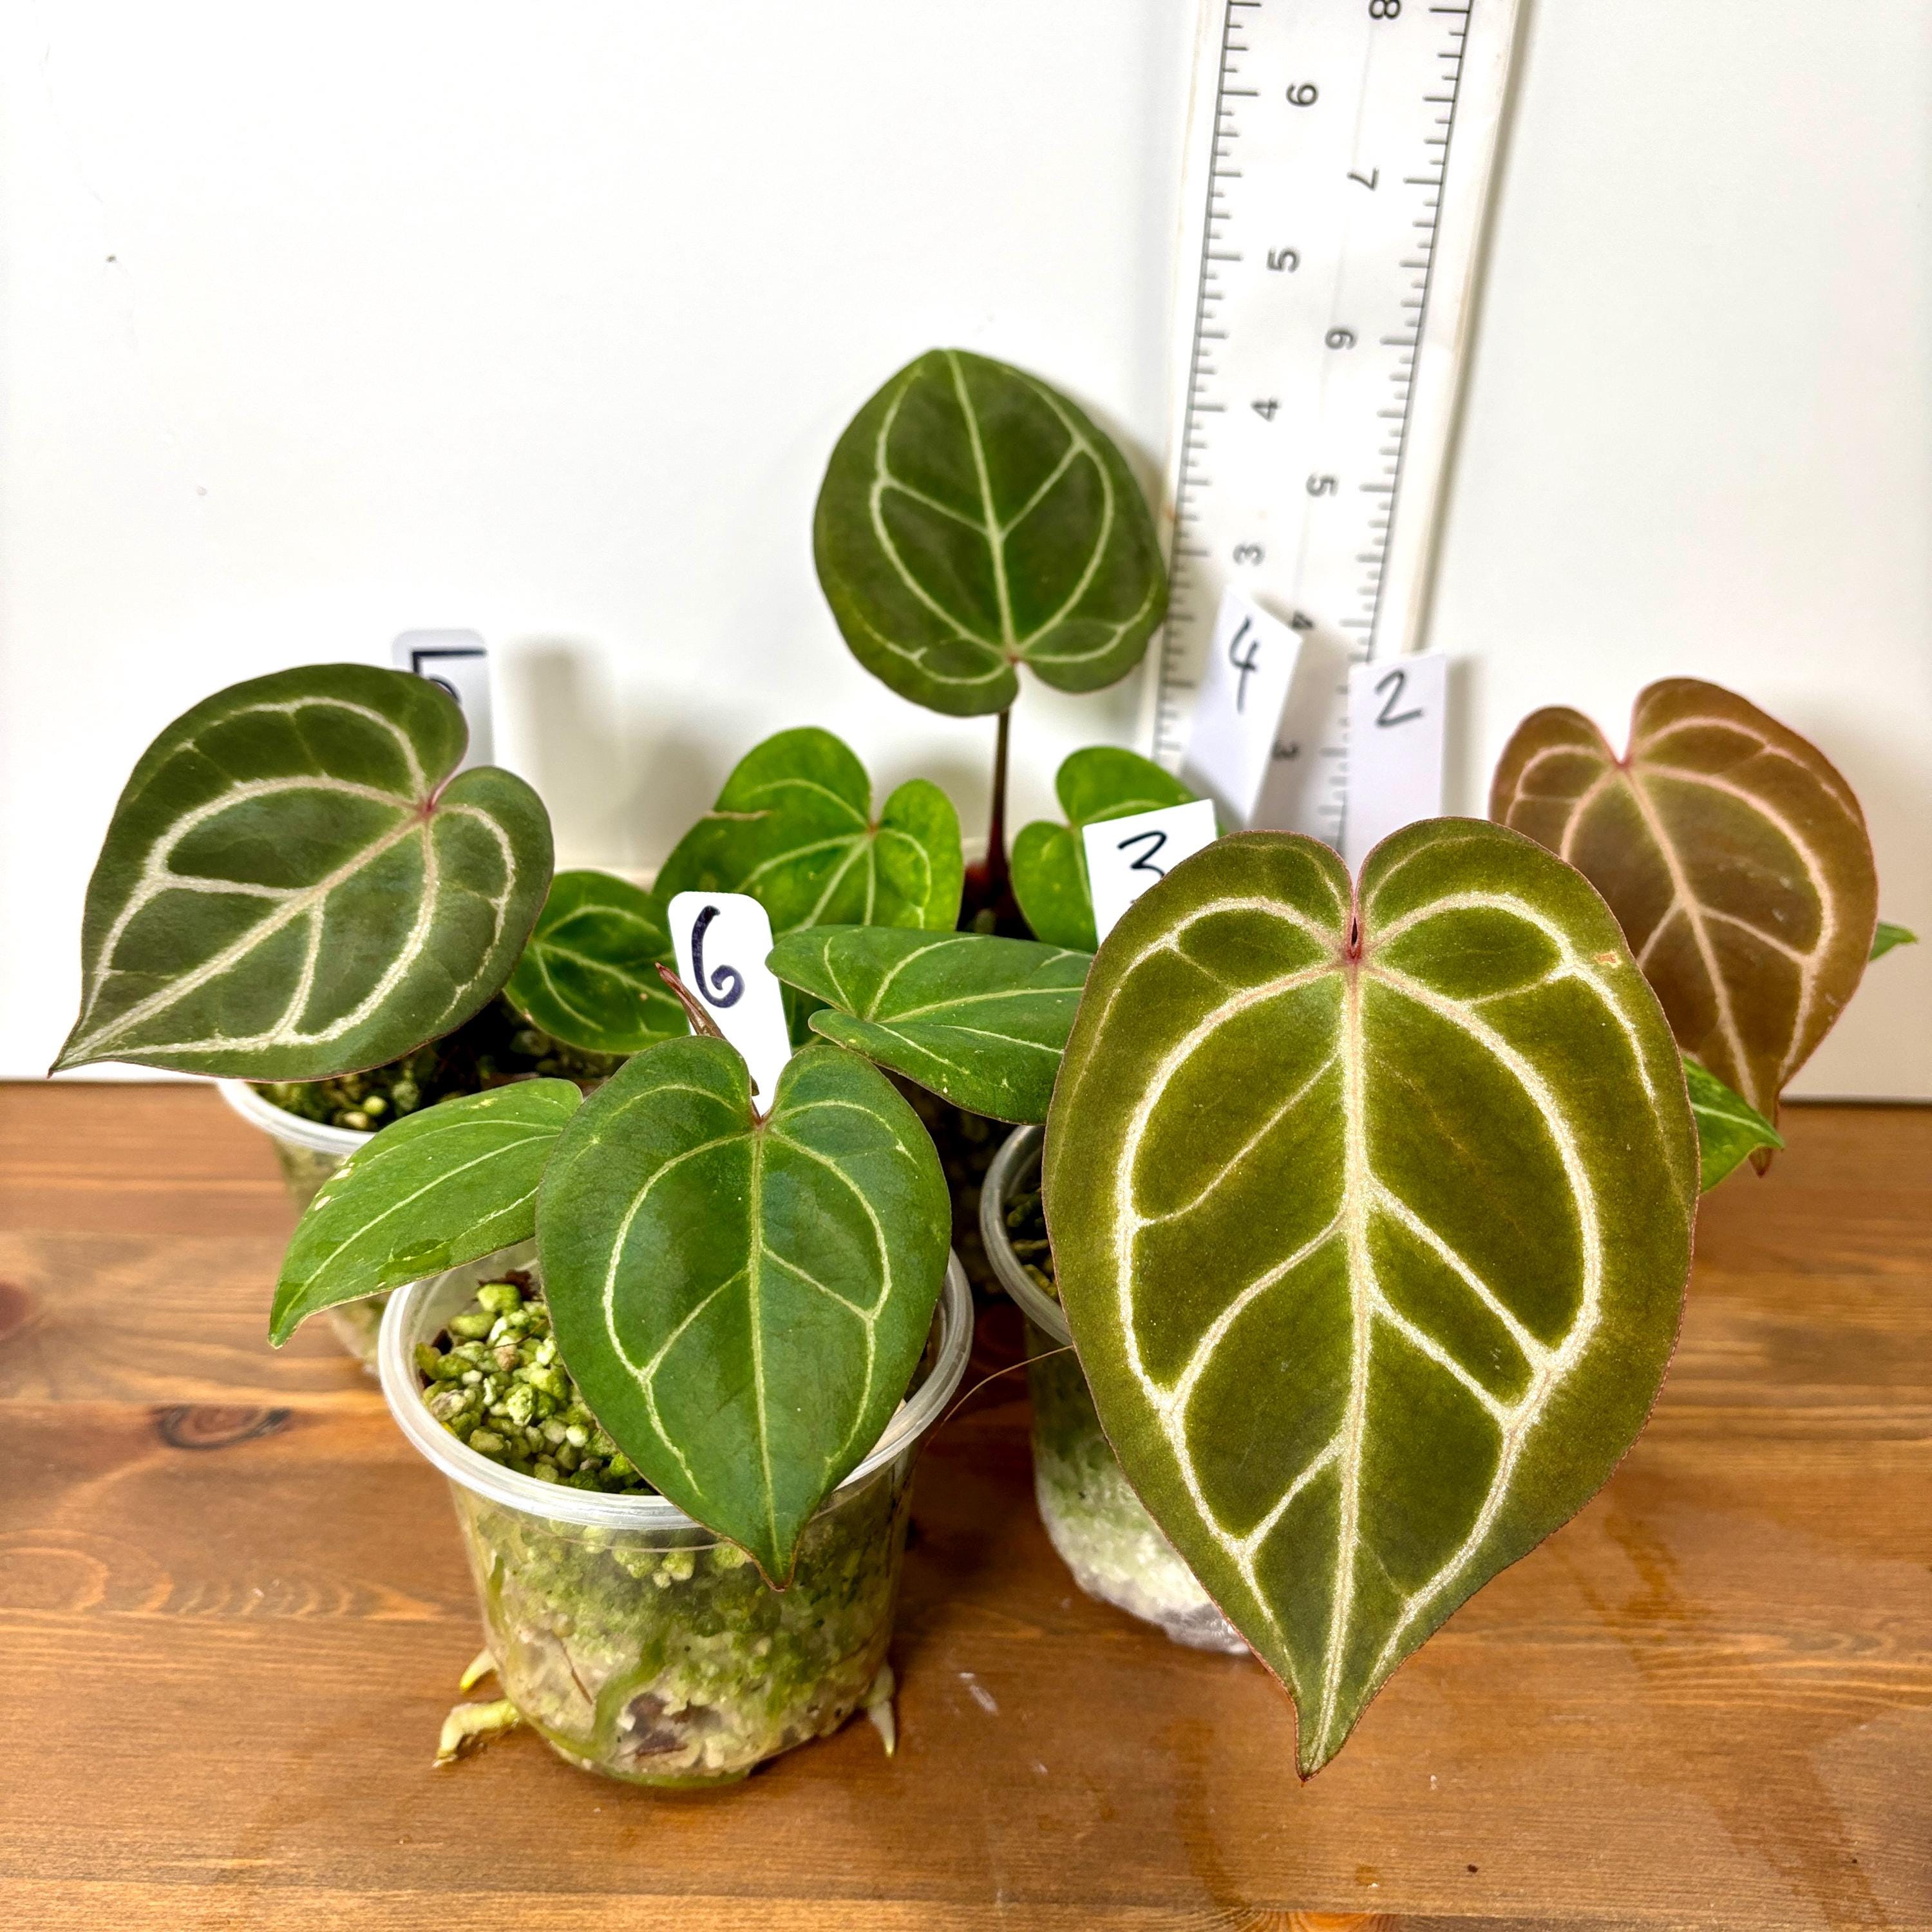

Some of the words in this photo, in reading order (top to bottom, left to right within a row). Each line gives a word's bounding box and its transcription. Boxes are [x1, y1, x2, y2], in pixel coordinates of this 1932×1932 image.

[1369, 0, 1401, 19] 8
[1348, 167, 1379, 190] 7
[1268, 248, 1299, 272] 5
[1252, 399, 1278, 421] 4
[1307, 475, 1336, 497] 5
[1234, 545, 1263, 564] 3
[1228, 616, 1259, 713] 4
[1374, 669, 1423, 728] 2
[691, 904, 746, 1009] 6
